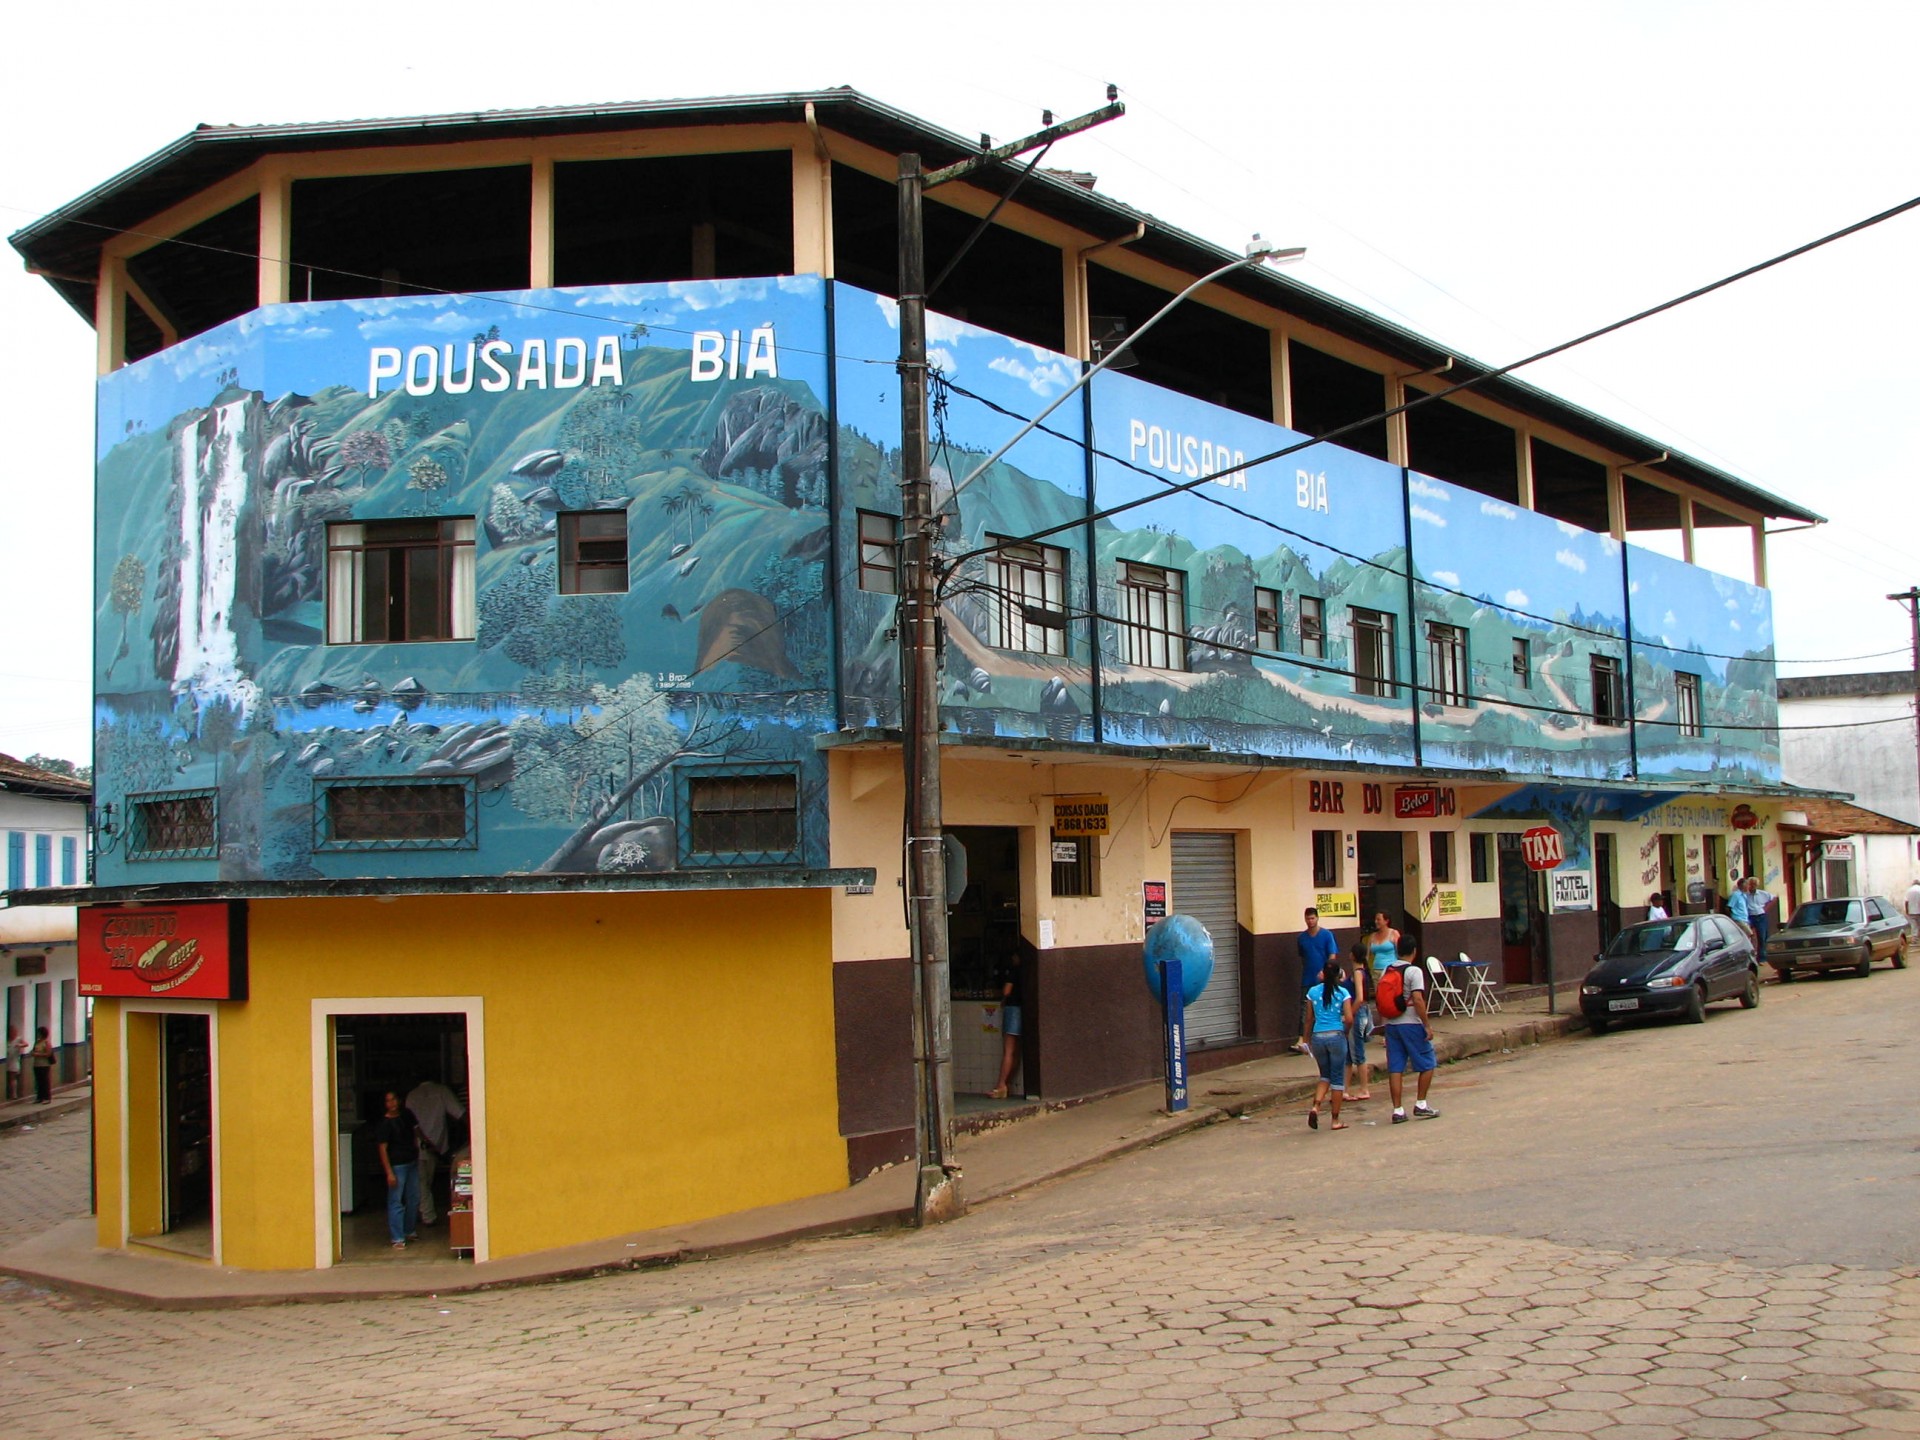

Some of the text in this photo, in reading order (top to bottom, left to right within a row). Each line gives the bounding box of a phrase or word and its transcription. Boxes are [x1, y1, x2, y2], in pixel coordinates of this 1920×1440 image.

[368, 321, 779, 399] POUSADA BIÁ
[1130, 418, 1329, 515] POUSADA BIÁ
[1055, 805, 1083, 817] COISAS
[1309, 780, 1382, 815] BAR DO
[1400, 793, 1429, 813] Belco
[1665, 804, 1727, 829] RESTAURANTE
[1522, 832, 1563, 862] TÁXI
[1555, 876, 1588, 890] HOTEL
[1555, 890, 1589, 902] FAMILIAR
[1173, 1024, 1181, 1060] TELEMAR
